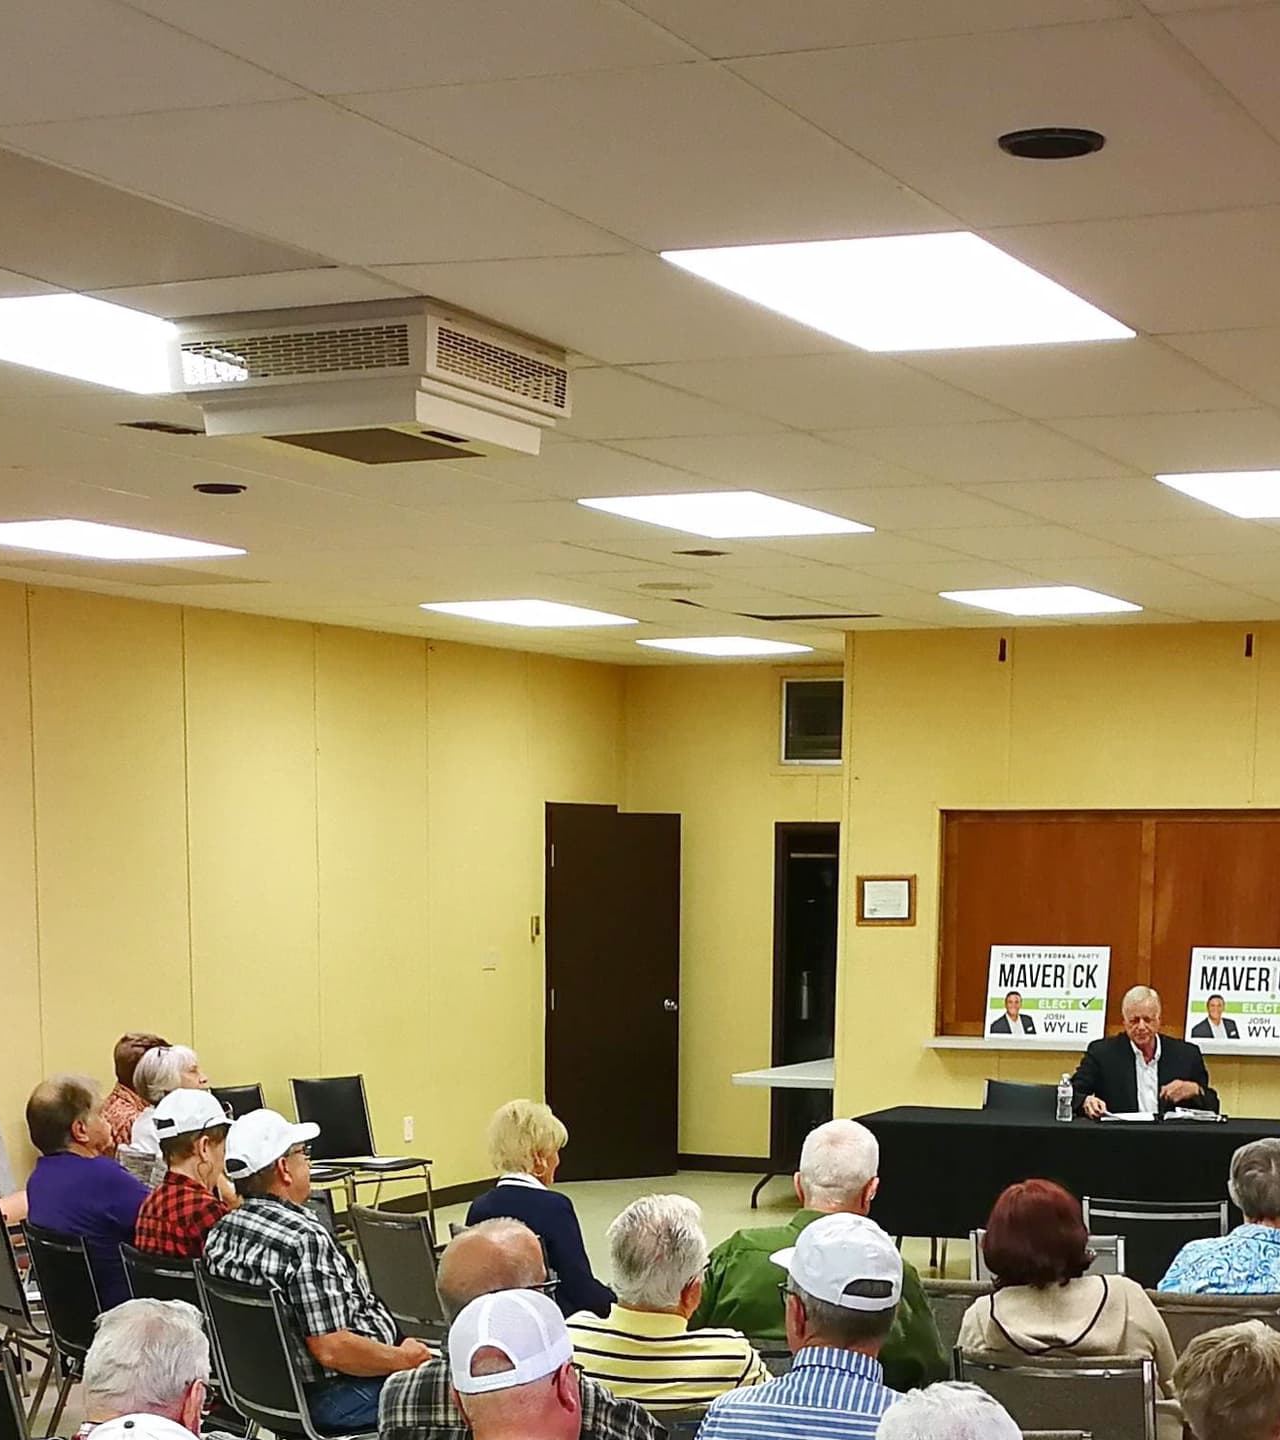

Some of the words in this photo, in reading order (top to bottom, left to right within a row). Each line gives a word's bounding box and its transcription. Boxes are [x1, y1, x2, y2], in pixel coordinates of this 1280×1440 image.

[1038, 1000, 1073, 1009] ELECT
[1241, 1003, 1279, 1013] ELECT
[1043, 1013, 1066, 1021] JOSH
[1247, 1017, 1271, 1025] JOSH
[1043, 1021, 1089, 1034] WYLIE
